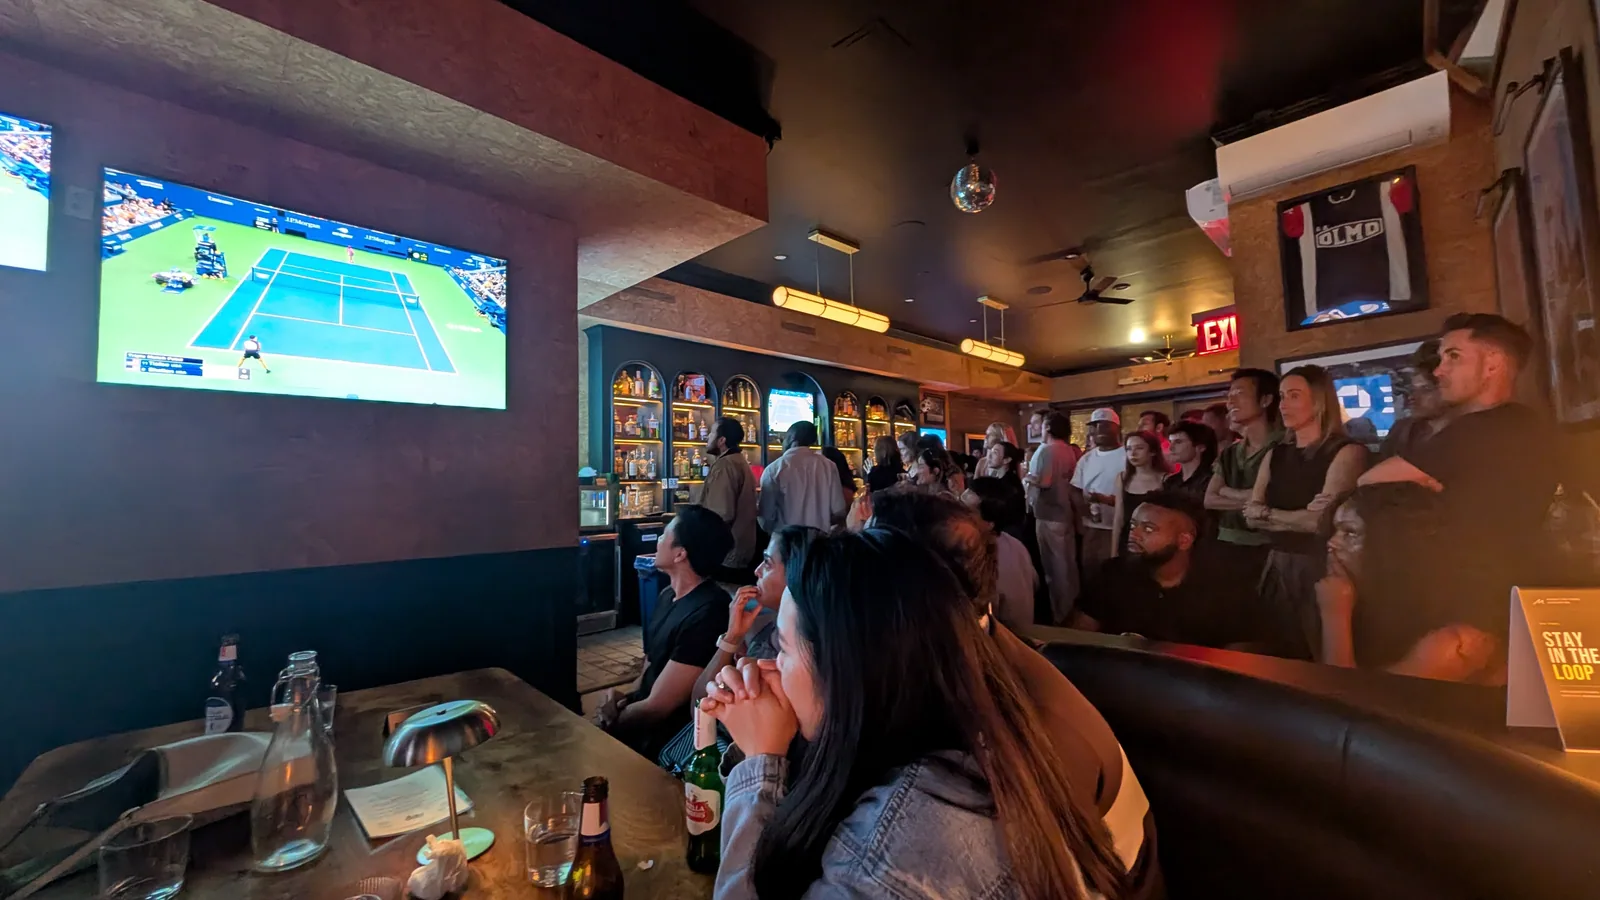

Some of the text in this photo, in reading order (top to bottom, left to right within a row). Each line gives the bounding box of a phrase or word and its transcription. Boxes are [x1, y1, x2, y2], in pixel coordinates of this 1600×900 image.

[1203, 316, 1238, 350] EXI
[1542, 631, 1583, 647] STAY
[1547, 647, 1600, 664] IN THE
[1552, 664, 1594, 680] LOOP
